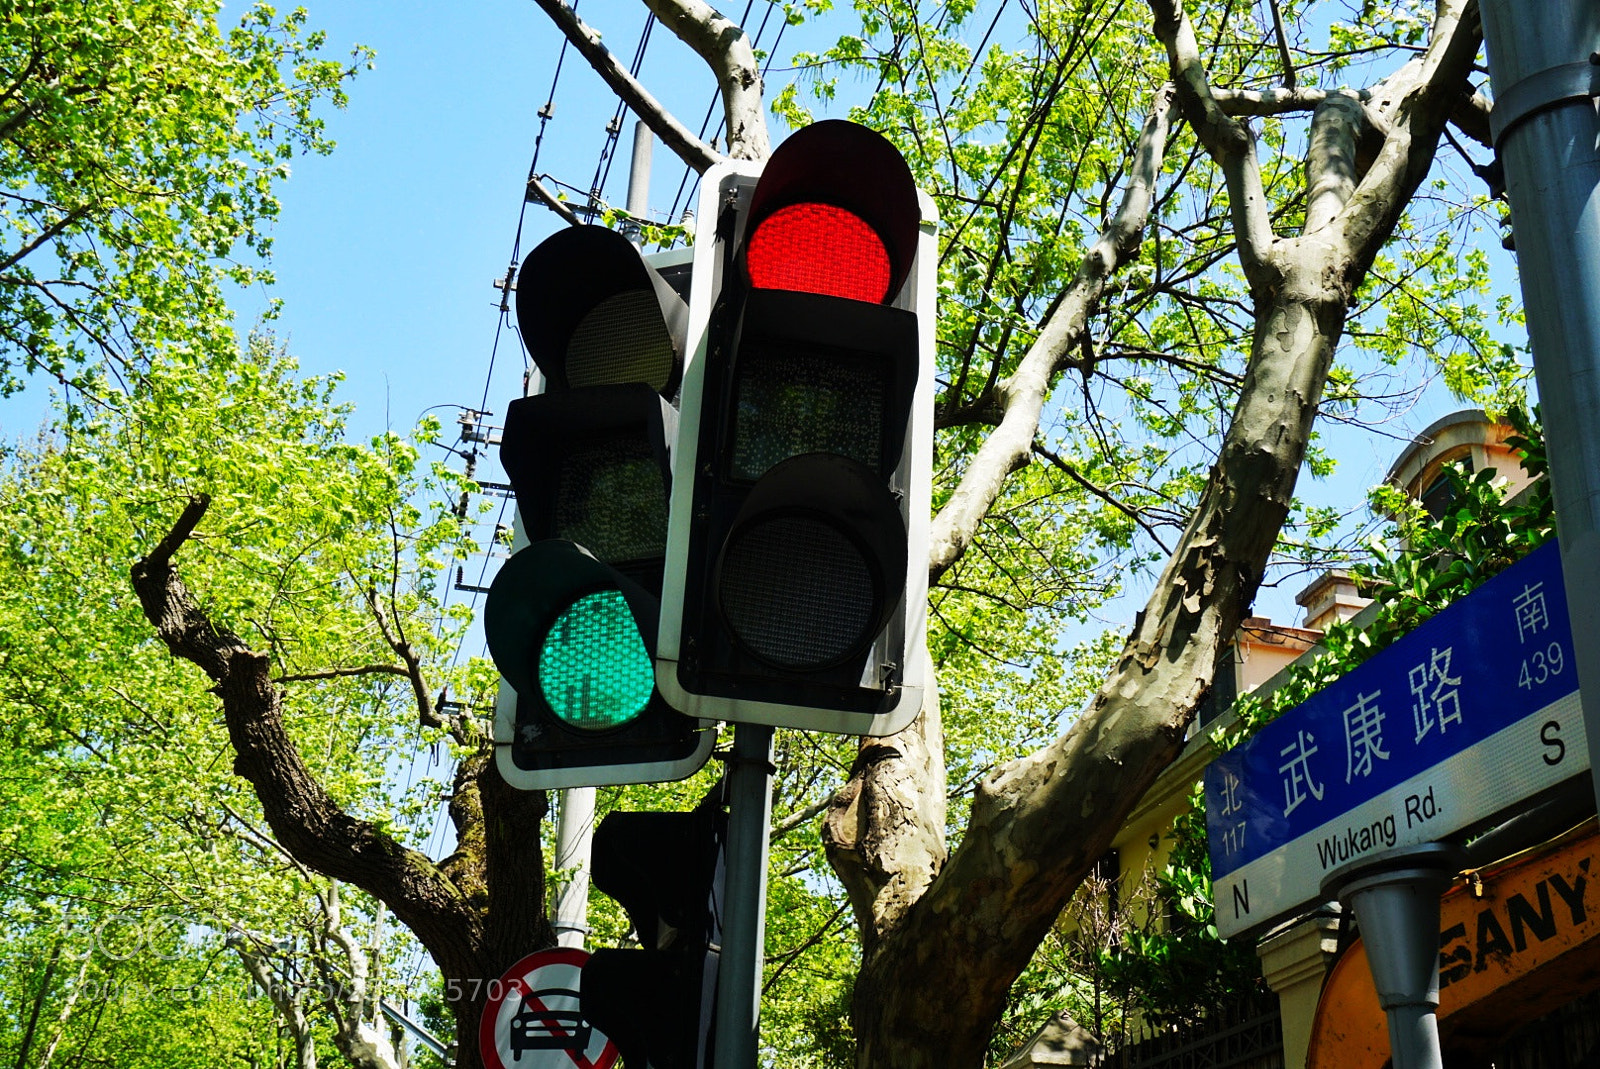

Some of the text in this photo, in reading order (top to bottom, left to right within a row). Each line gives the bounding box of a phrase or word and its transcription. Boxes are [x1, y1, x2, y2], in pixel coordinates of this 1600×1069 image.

[1512, 580, 1549, 645] 南
[1517, 641, 1564, 691] 439
[1277, 645, 1463, 819] 武康路
[1539, 720, 1566, 767] S
[1220, 774, 1243, 817] 北
[1221, 821, 1247, 857] 117
[1316, 785, 1442, 871] Wukang Rd.
[1232, 877, 1250, 920] N
